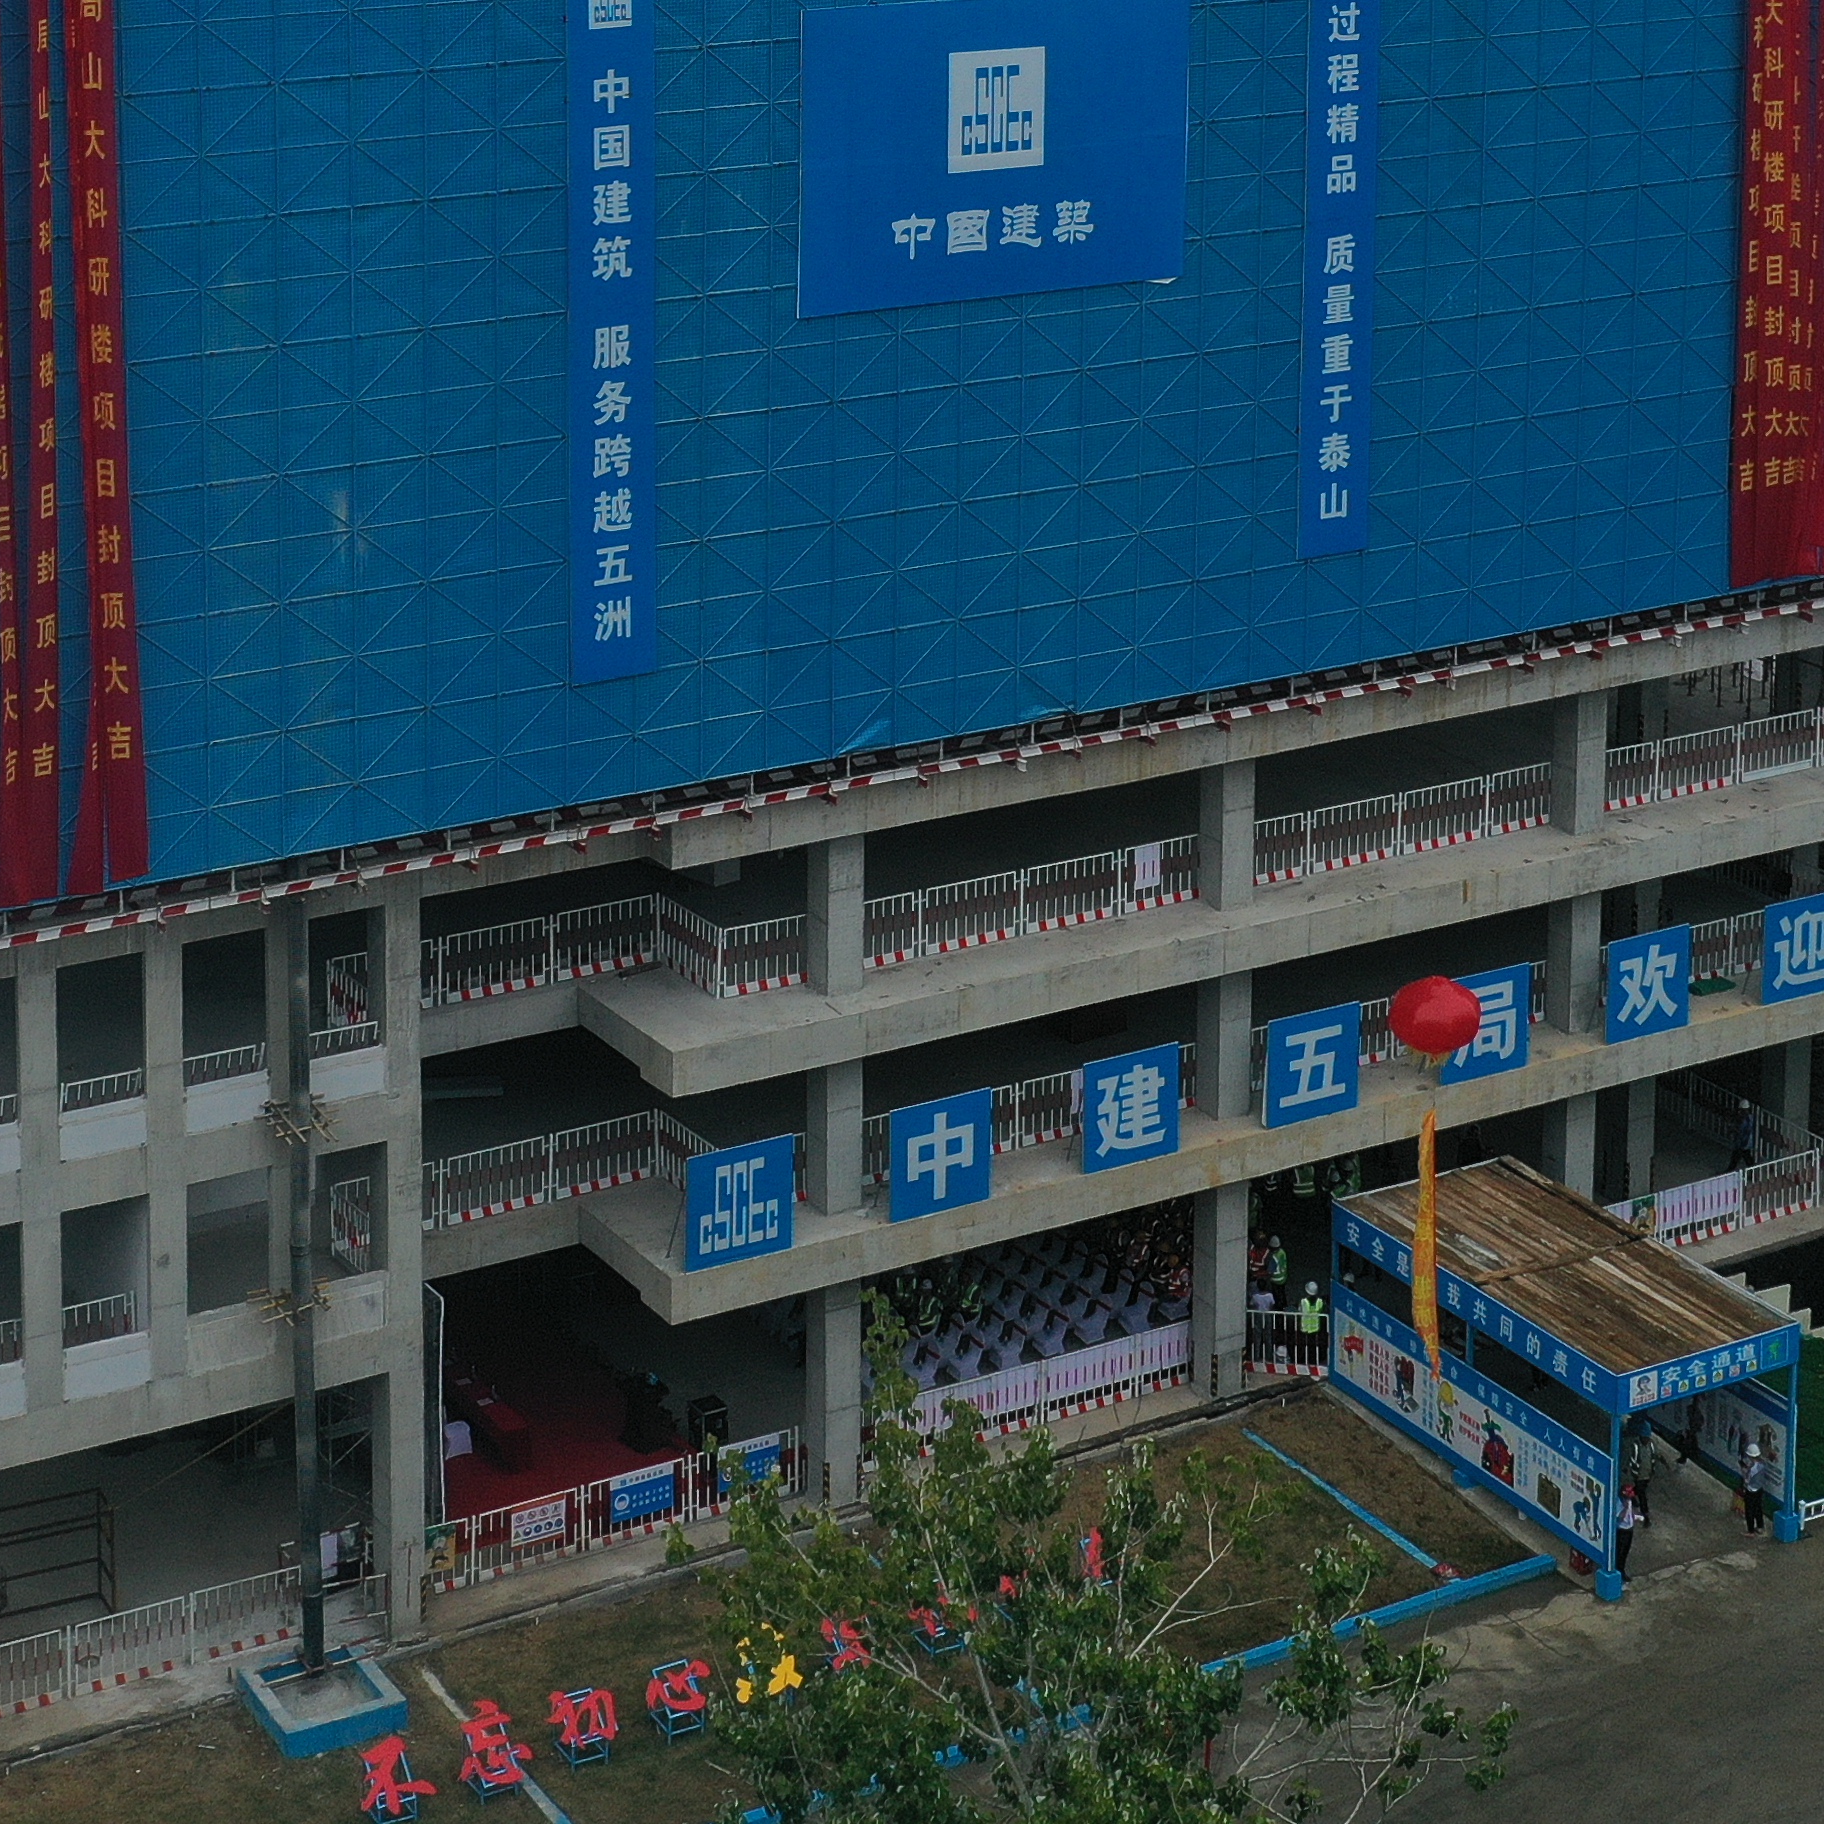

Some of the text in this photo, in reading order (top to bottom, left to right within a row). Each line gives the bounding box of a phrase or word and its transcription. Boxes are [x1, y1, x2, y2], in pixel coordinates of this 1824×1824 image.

[1319, 3, 1361, 520] 过程精品 质量重于泰山
[592, 68, 633, 641] 中国建筑 服务跨越五洲
[1347, 1221, 1598, 1394] 安全是我共同的责任
[1662, 1342, 1757, 1386] 安全通道
[361, 1659, 711, 1815] 不忘初心
